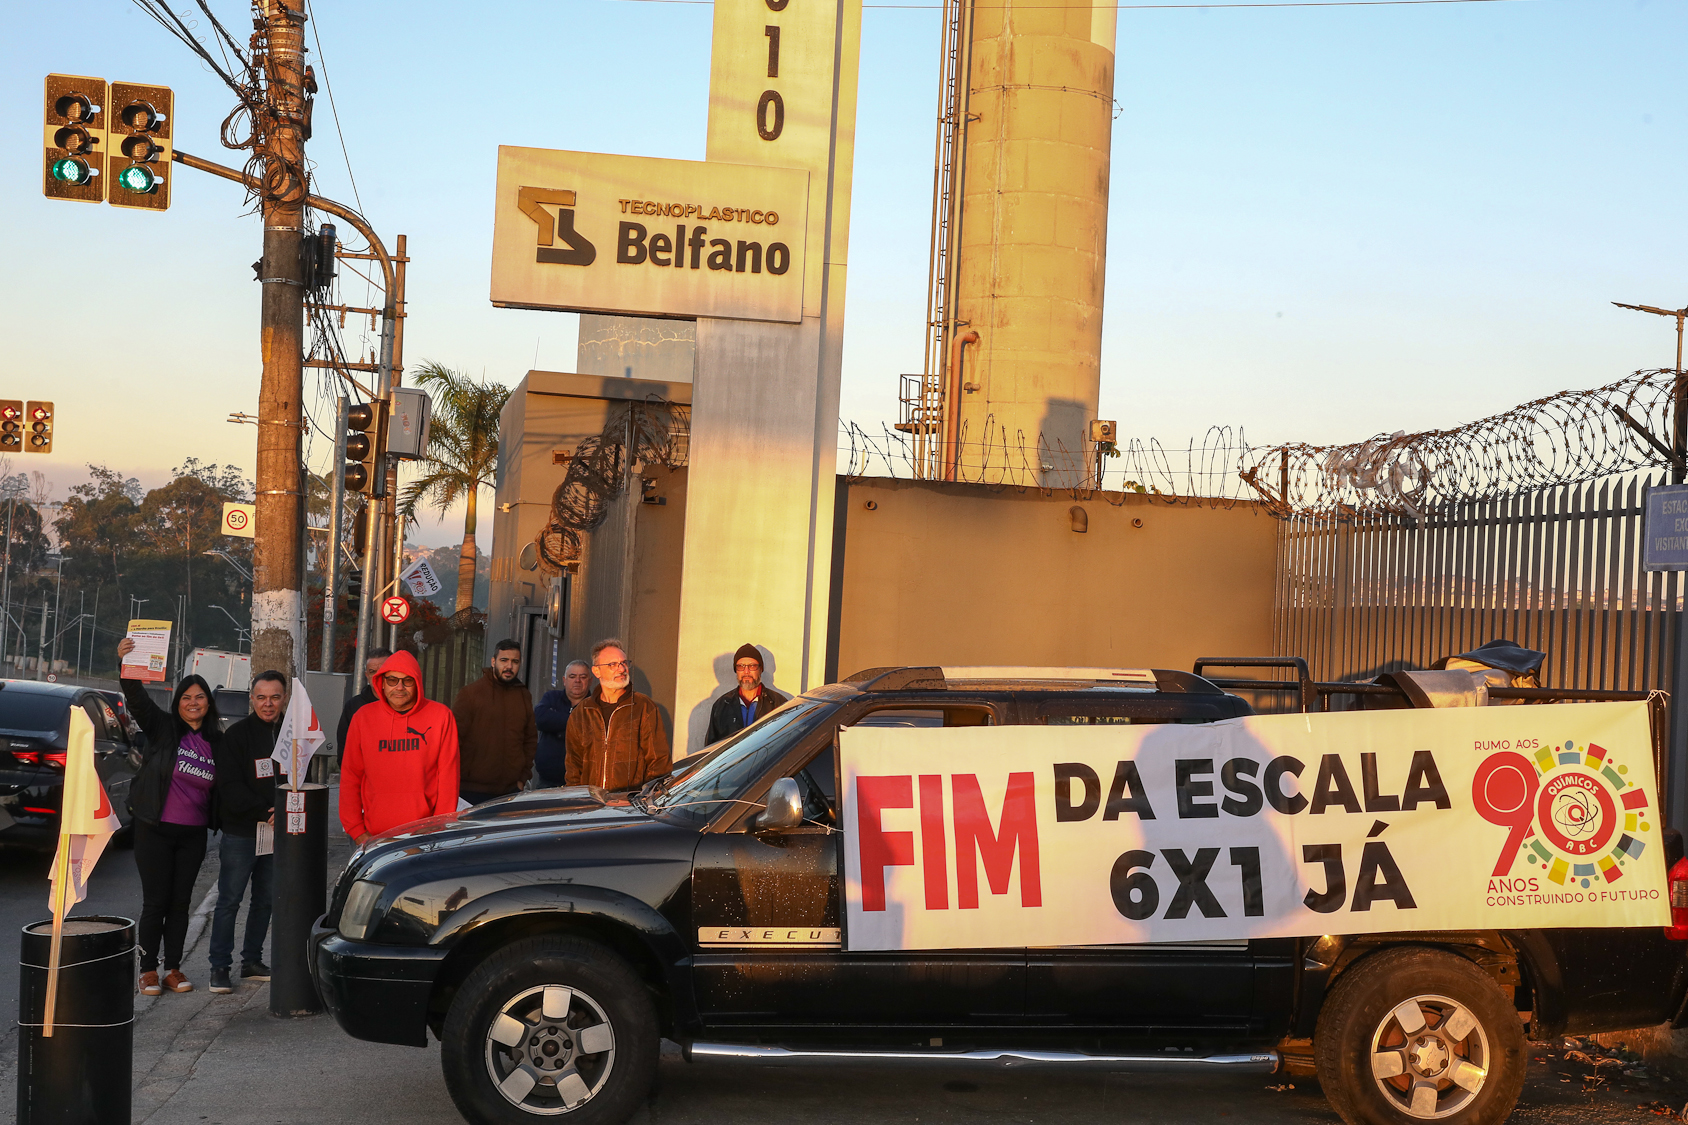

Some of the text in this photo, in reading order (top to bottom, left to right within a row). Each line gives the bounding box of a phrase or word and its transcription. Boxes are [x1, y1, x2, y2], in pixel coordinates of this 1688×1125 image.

[756, 0, 790, 141] 10
[618, 199, 780, 226] TECNOPLASTICO
[616, 221, 791, 275] Belfano
[231, 514, 245, 524] 50
[420, 562, 439, 592] REDUÇÃO
[177, 746, 199, 760] peite
[378, 738, 420, 752] PUMA
[1474, 738, 1539, 751] RUMO AOS
[1053, 750, 1452, 823] DA ESCALA
[1548, 775, 1599, 796] QUÍMICOS
[856, 771, 1043, 912] FIM
[1109, 819, 1419, 921] 6X1 JÁ
[1486, 877, 1540, 894] ANOS
[1486, 889, 1660, 907] CONSTRUINDO O FUTURO
